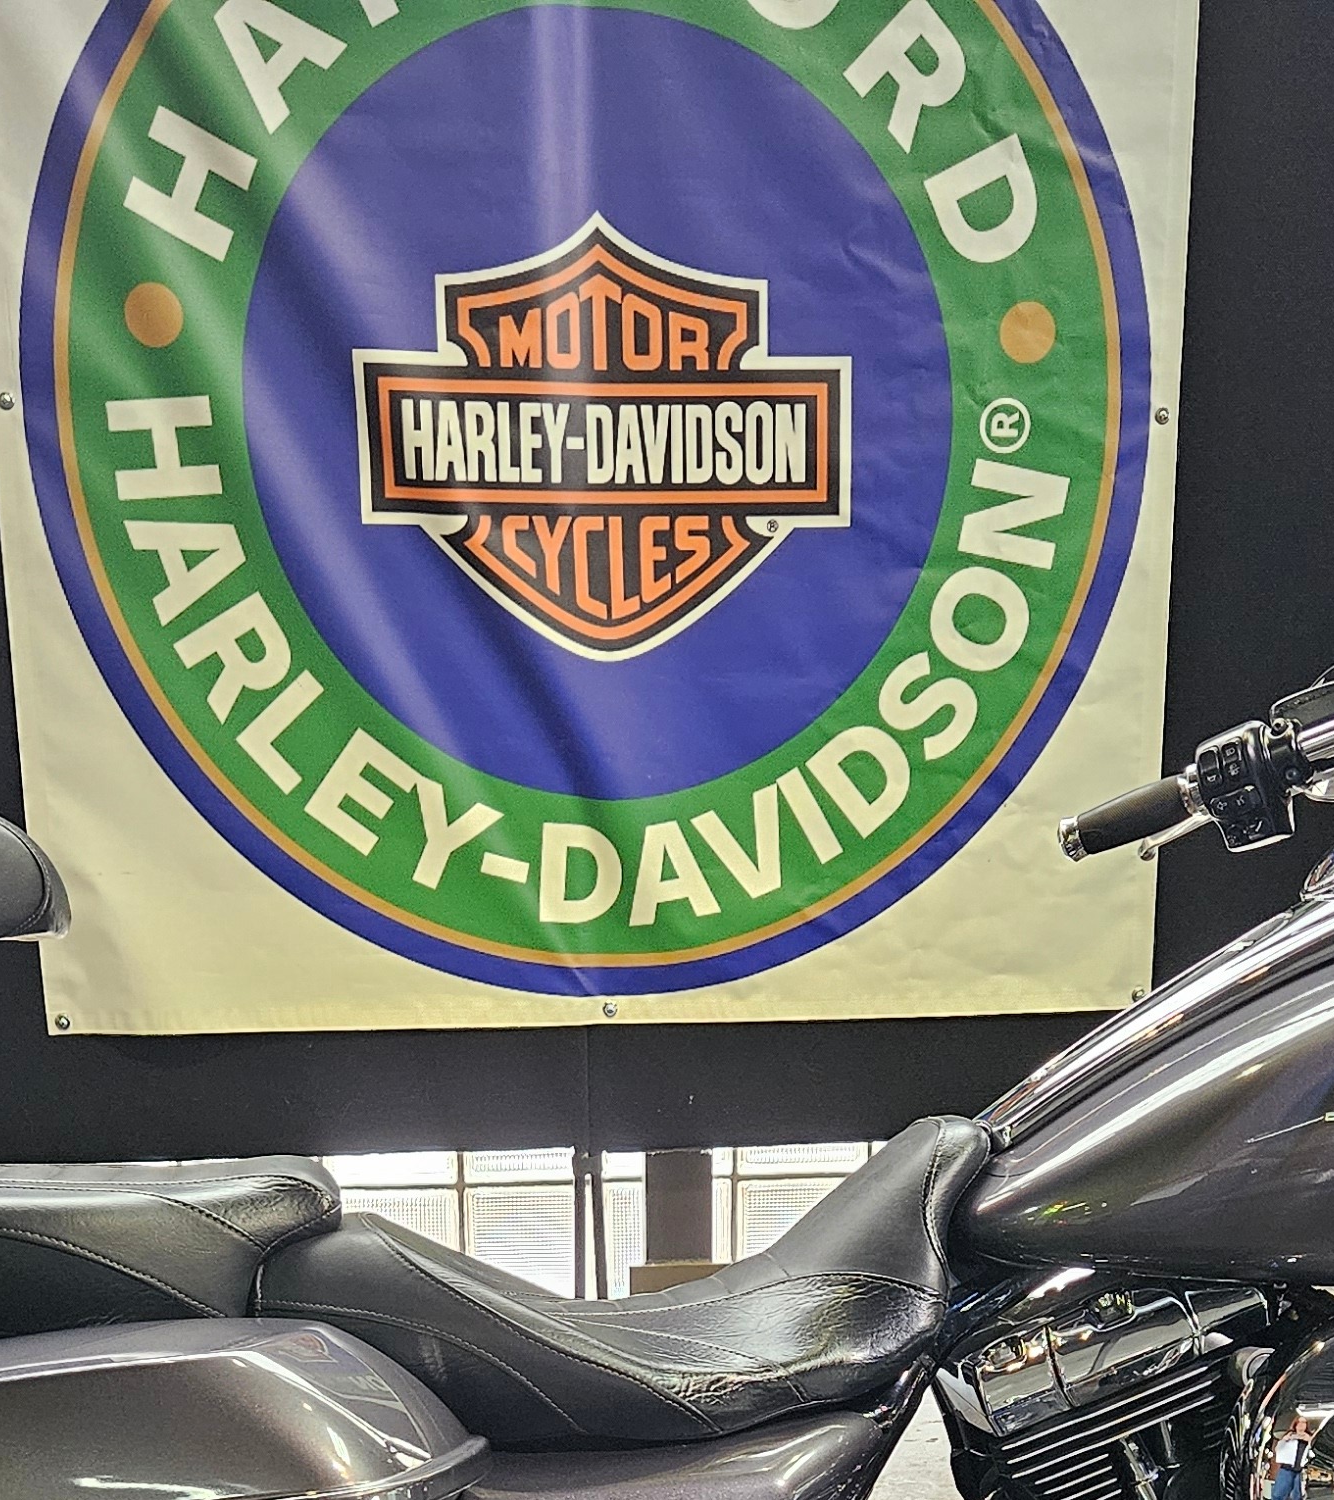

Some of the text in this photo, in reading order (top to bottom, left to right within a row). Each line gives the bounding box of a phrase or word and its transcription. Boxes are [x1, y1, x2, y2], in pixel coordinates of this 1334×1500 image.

[123, 0, 1038, 263] HARD
[498, 274, 710, 371] MOTOR
[401, 398, 807, 484] HARLEY-DAVIDSON
[501, 515, 711, 620] CYCLES
